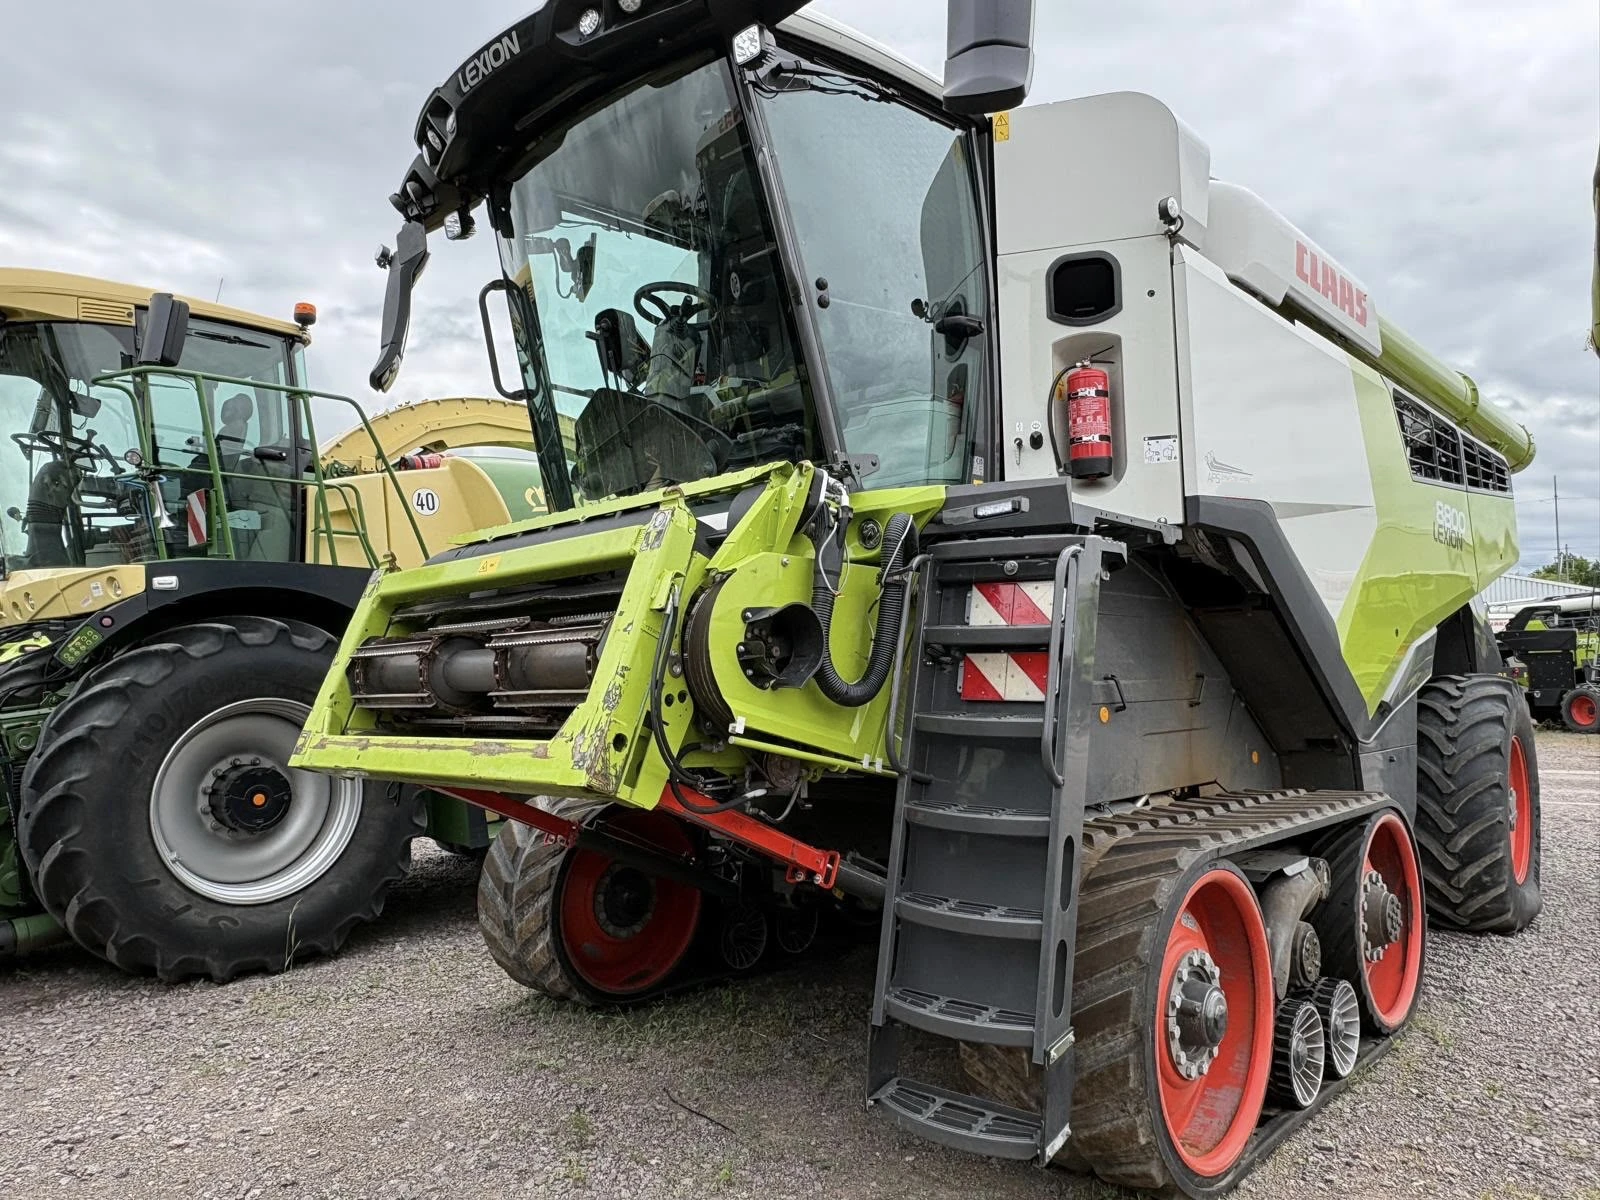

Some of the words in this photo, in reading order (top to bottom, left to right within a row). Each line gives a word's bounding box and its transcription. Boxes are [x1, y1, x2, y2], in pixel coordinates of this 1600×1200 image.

[458, 30, 521, 93] LEXION
[1296, 240, 1368, 328] CLAAS
[416, 492, 436, 511] 40
[1436, 500, 1466, 535] 8800
[1432, 521, 1464, 552] LEXION
